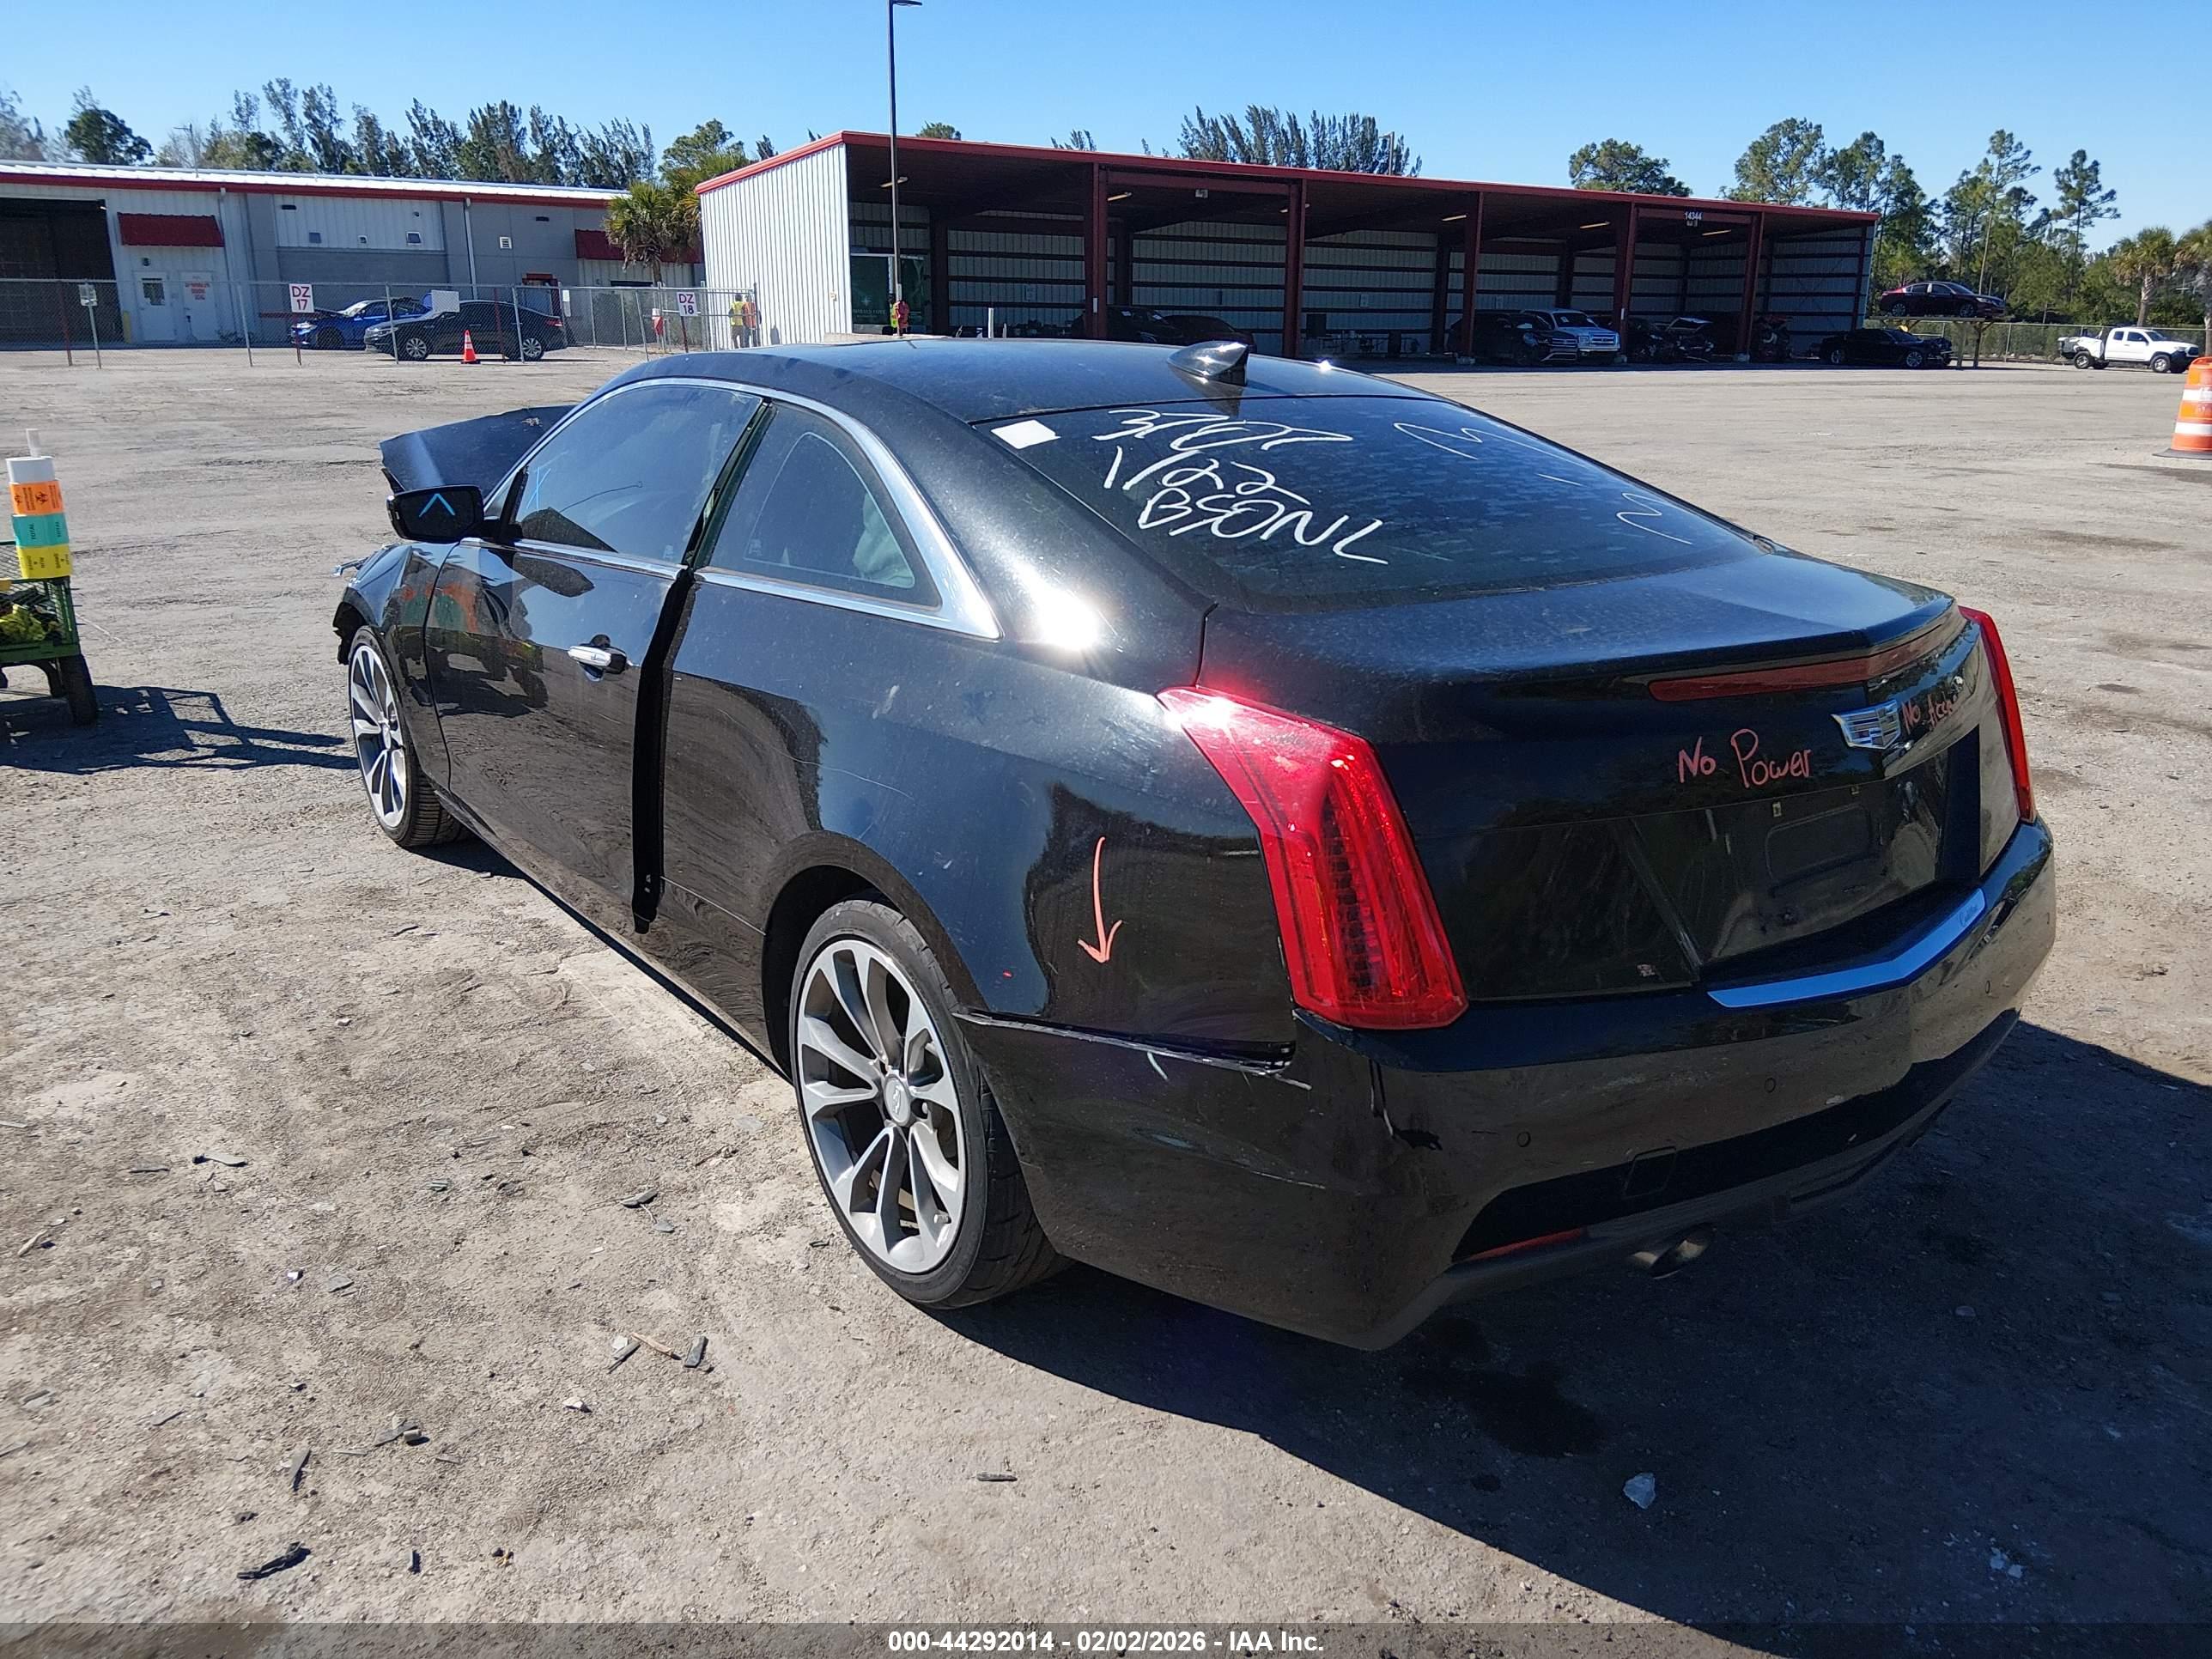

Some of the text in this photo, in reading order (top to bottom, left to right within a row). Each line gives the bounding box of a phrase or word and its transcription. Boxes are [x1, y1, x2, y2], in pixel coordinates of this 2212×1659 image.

[292, 286, 311, 298] DZ
[678, 293, 695, 304] DZ
[296, 300, 308, 311] 17
[683, 304, 695, 314] 18
[1901, 700, 1921, 736] No
[1678, 728, 1813, 788] No Power
